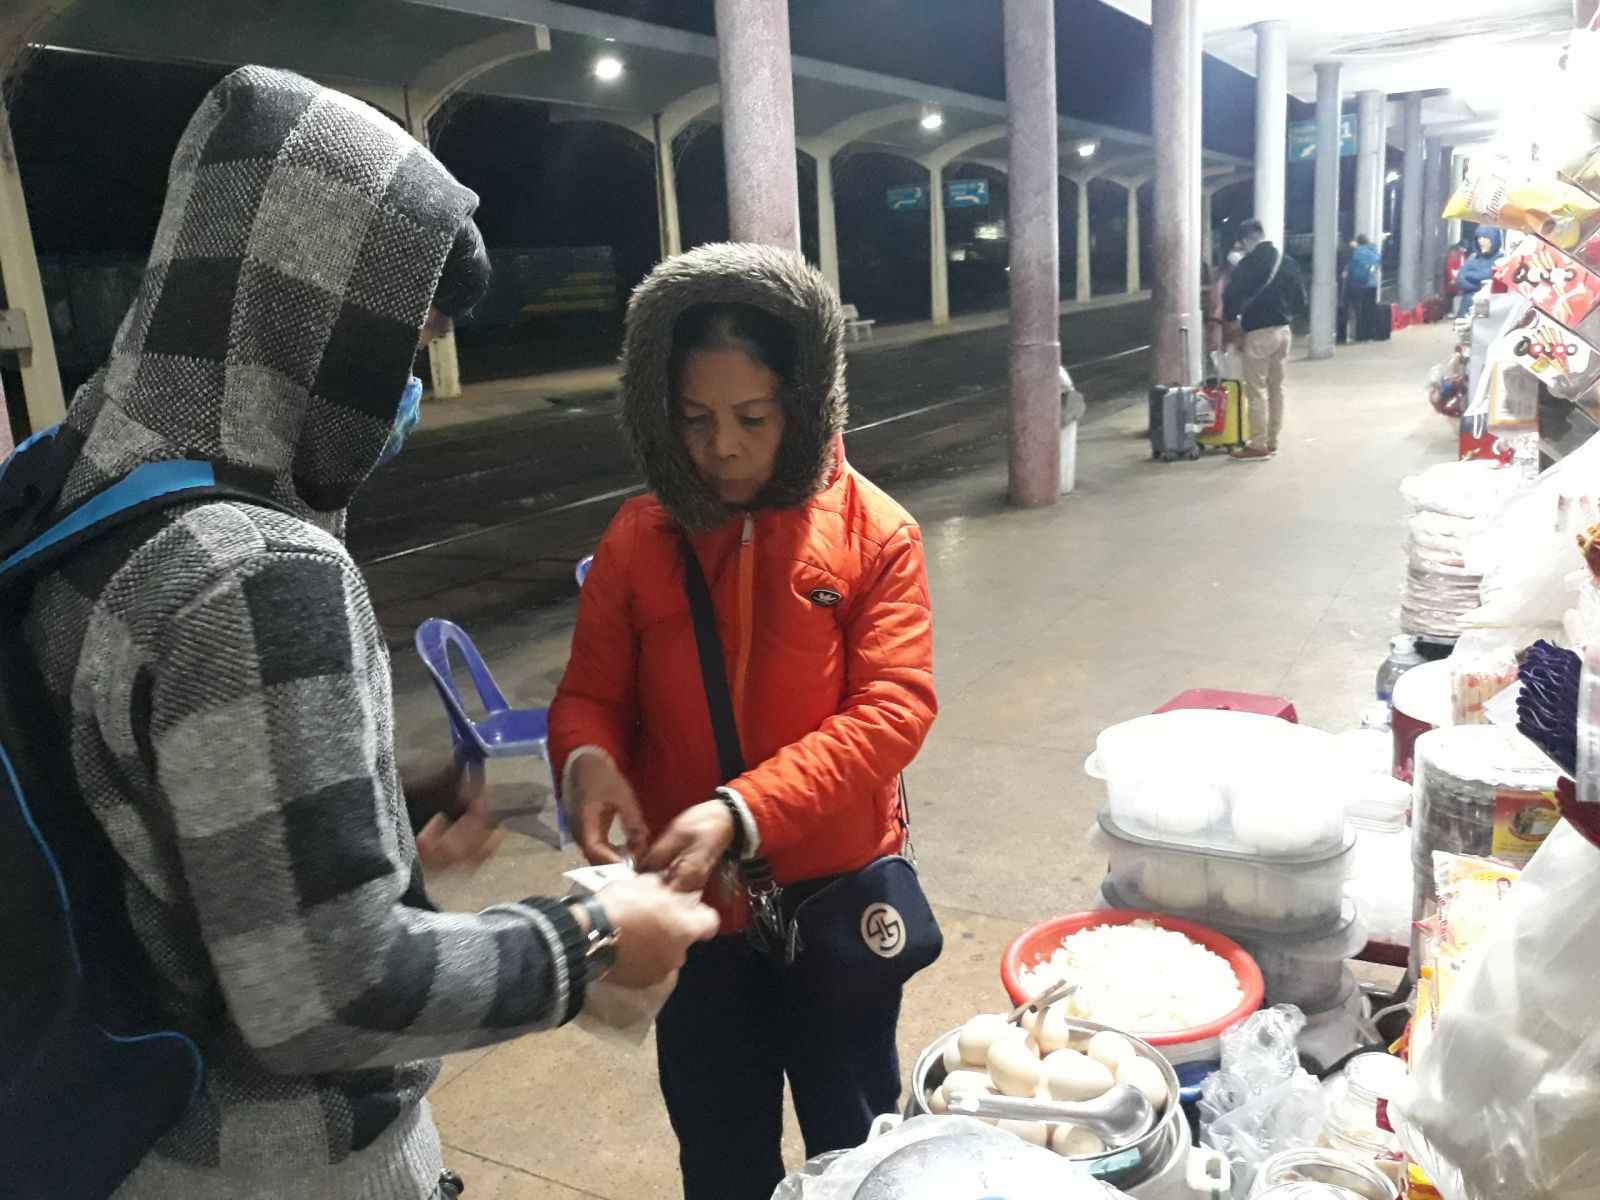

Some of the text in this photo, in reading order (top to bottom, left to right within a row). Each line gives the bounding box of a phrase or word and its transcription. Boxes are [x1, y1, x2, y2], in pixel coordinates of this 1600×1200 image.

[1340, 121, 1353, 138] 1
[914, 187, 922, 198] 3
[977, 182, 985, 193] 2
